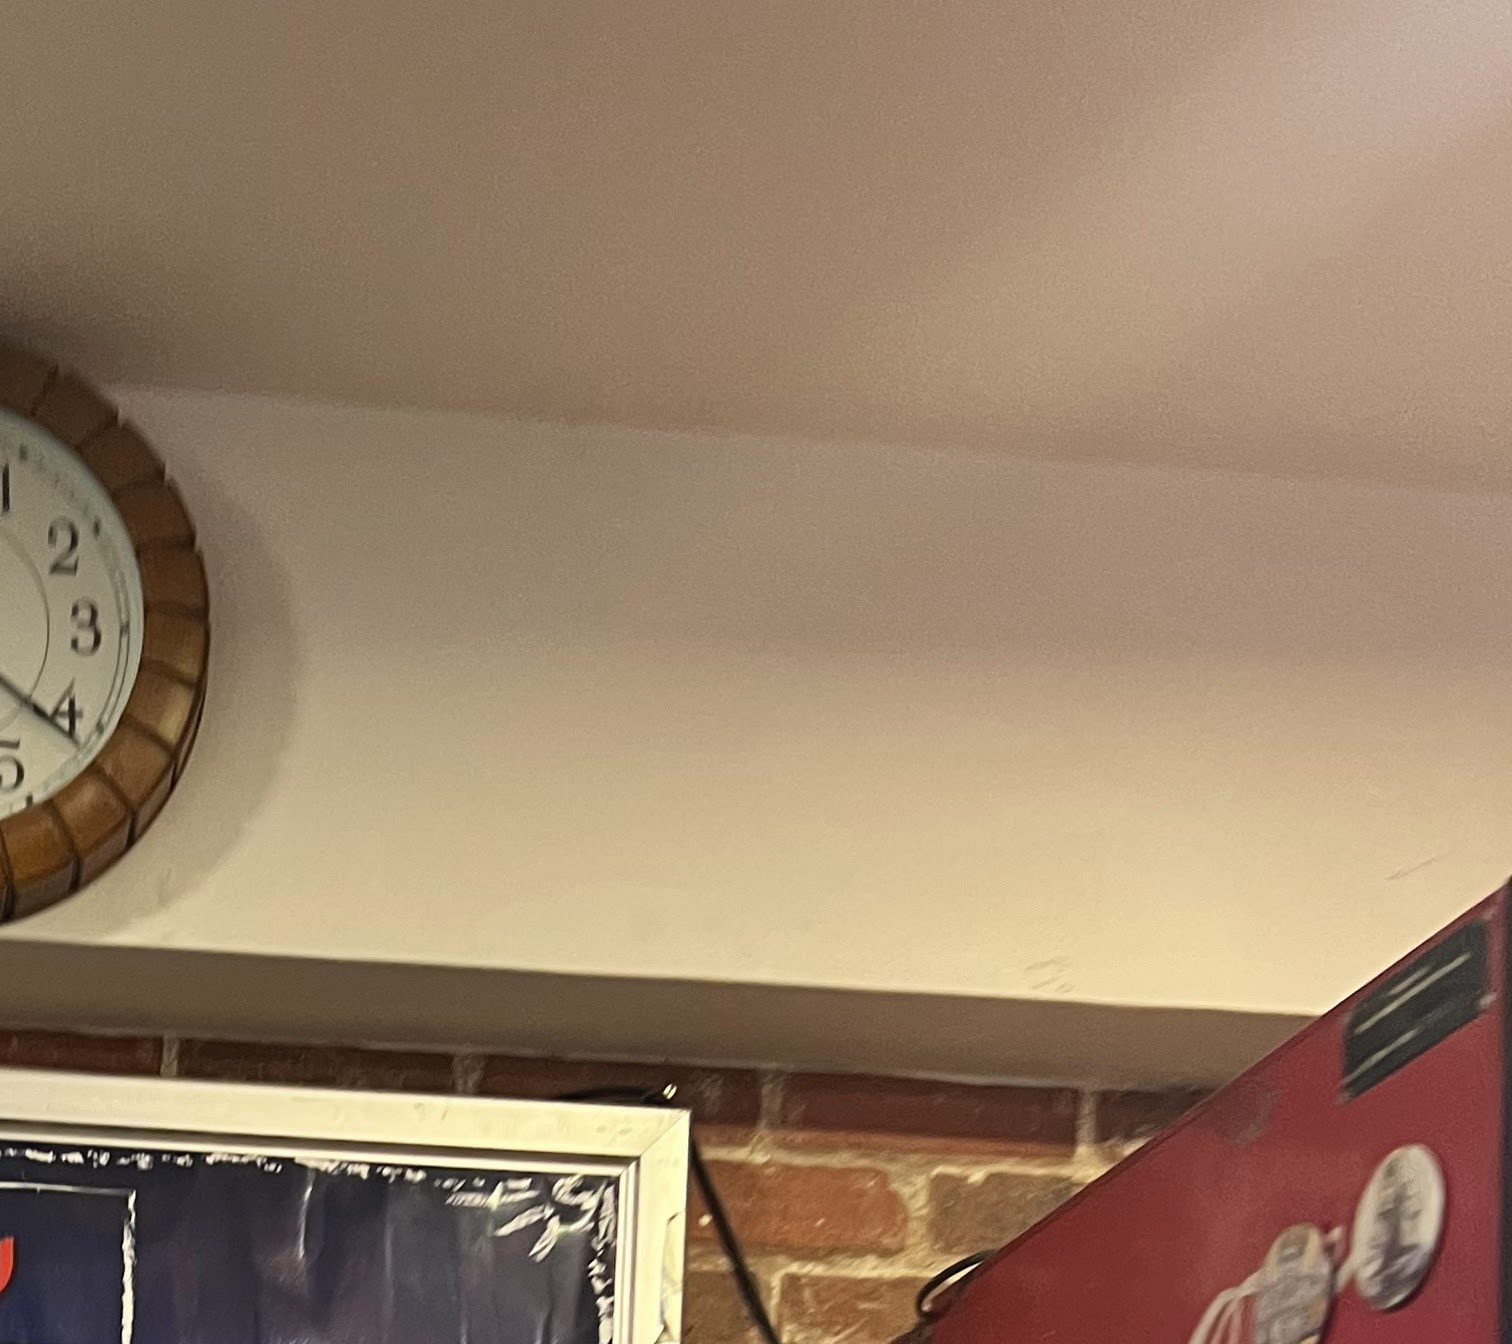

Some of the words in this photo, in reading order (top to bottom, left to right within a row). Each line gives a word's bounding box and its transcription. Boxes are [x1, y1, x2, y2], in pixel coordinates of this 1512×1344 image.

[1, 463, 11, 516] 1
[47, 517, 80, 576] 2
[70, 601, 102, 657] 3
[50, 677, 84, 737] 4
